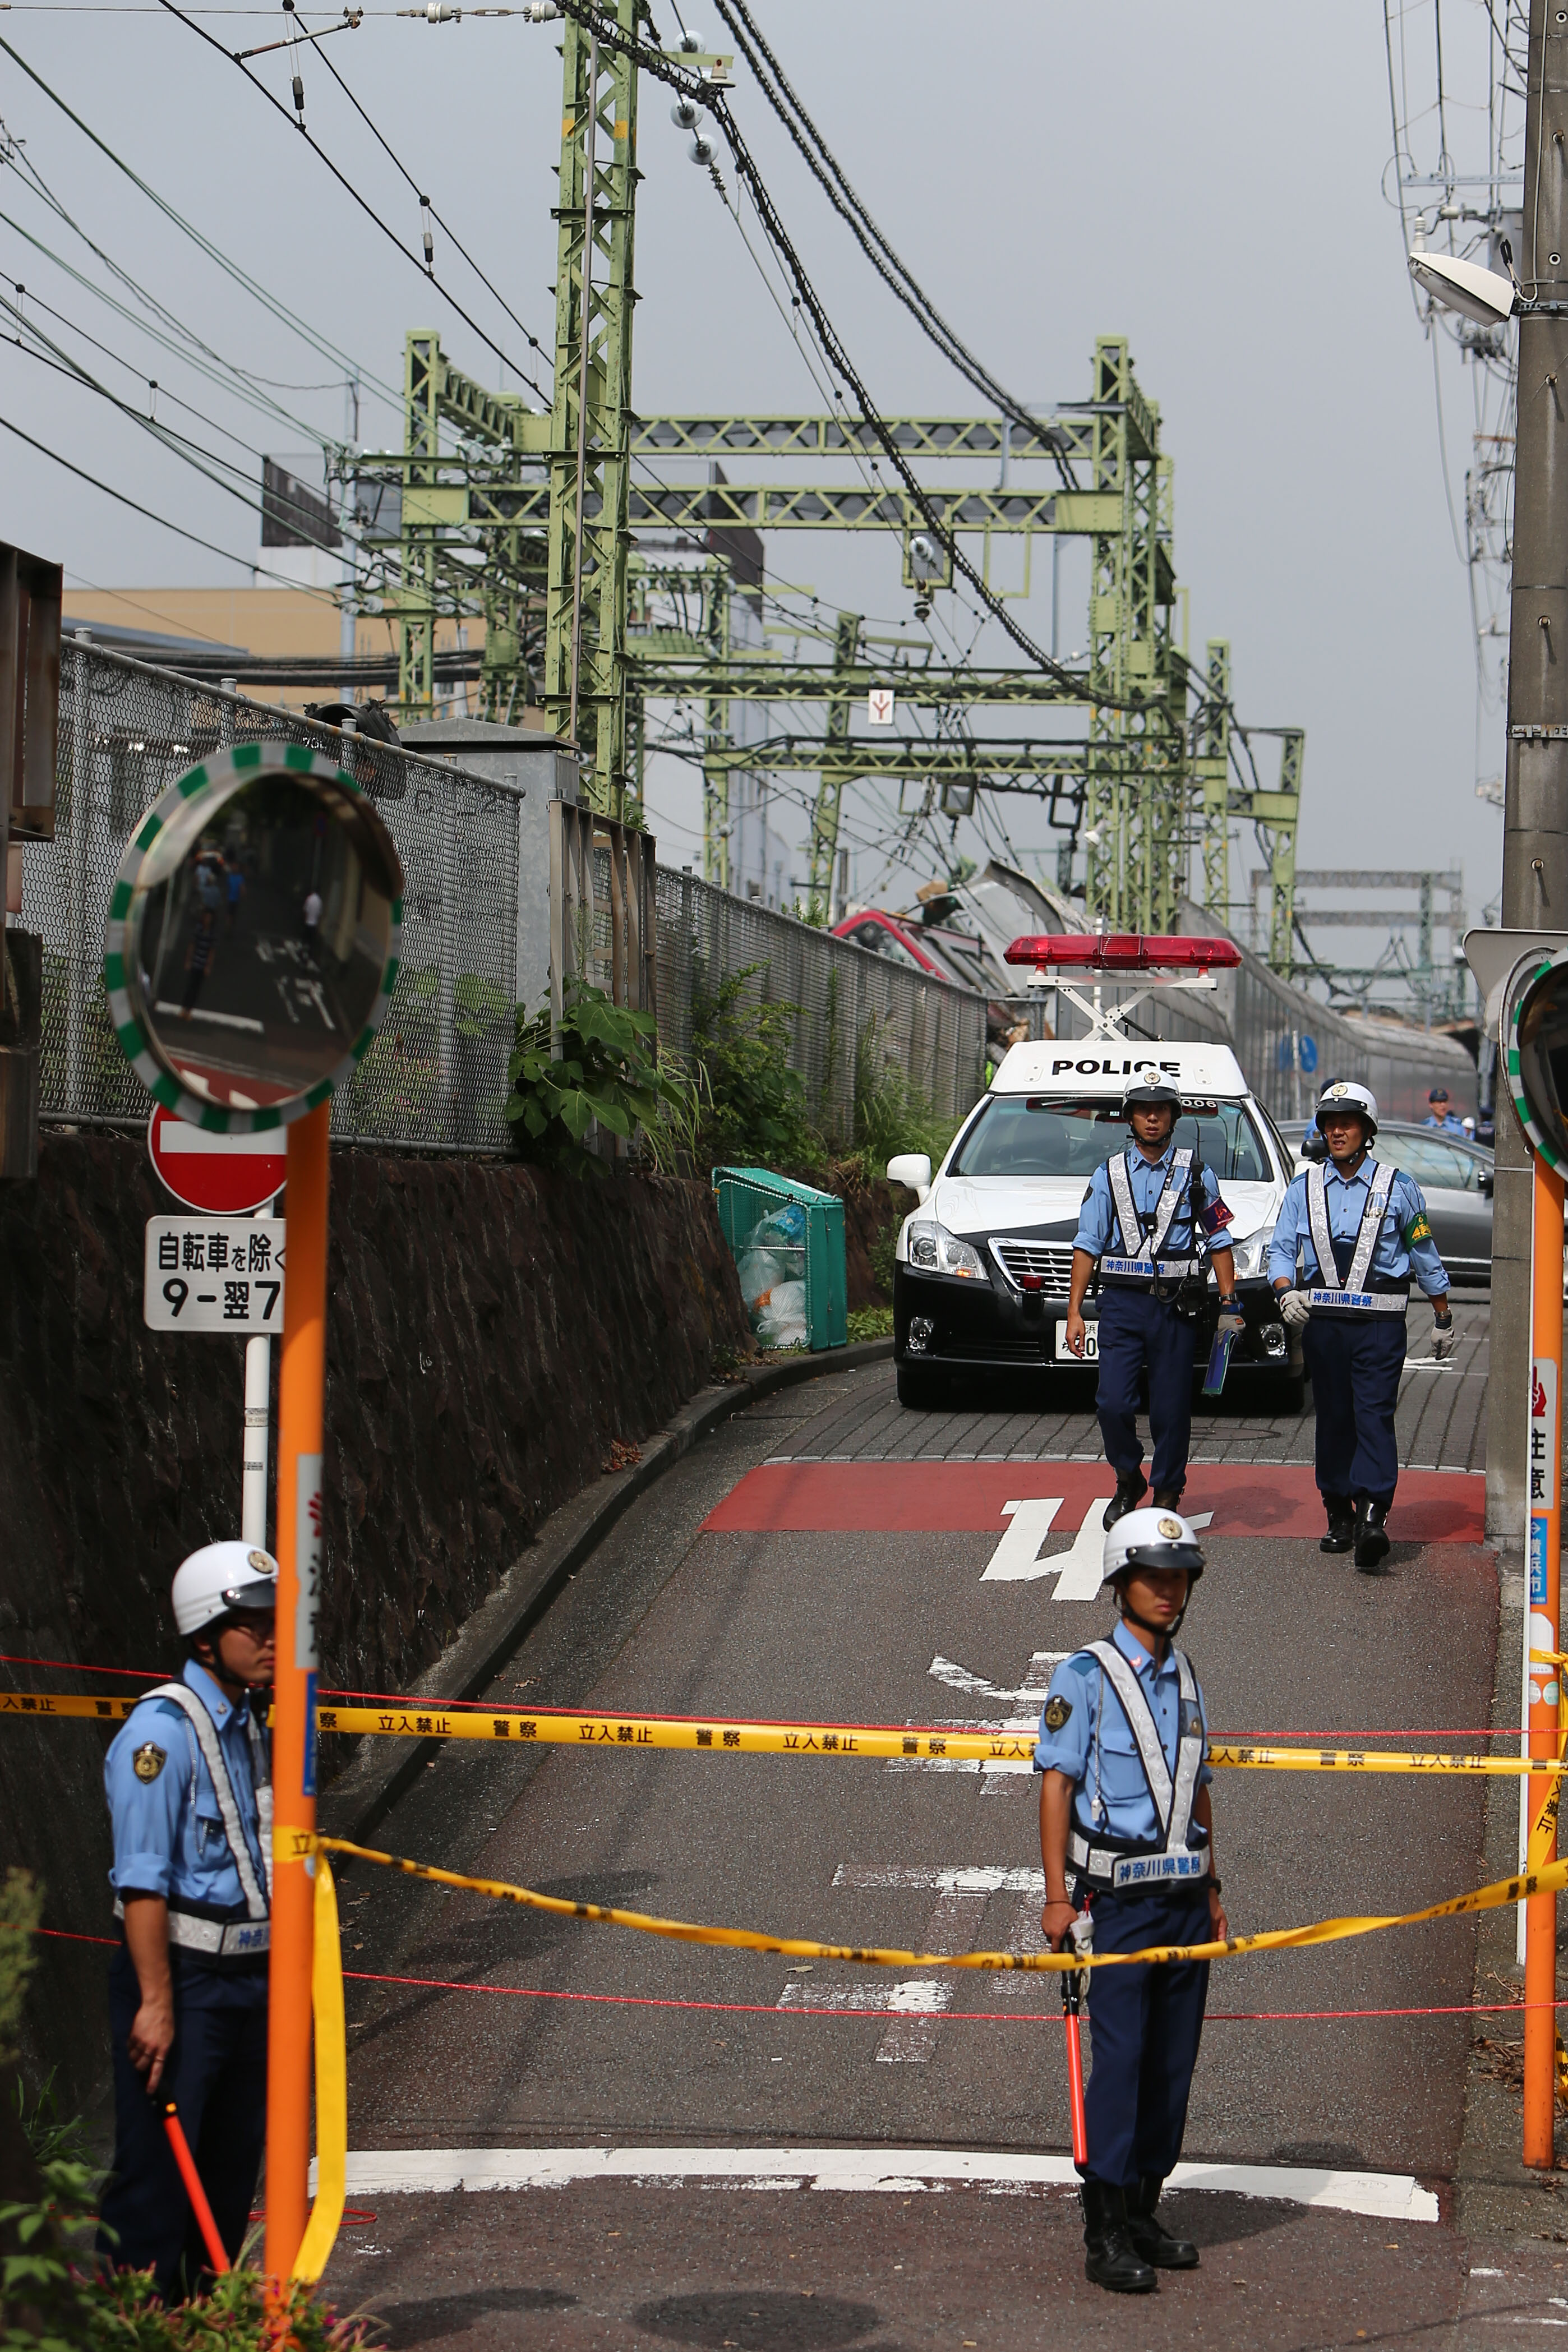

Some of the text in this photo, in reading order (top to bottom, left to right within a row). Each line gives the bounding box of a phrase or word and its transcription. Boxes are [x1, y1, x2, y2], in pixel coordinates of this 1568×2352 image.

[1052, 1060, 1180, 1077] POLICE
[159, 1232, 287, 1273] 自転車を除く
[1106, 1260, 1165, 1275] 神奈川県警察
[1313, 1292, 1372, 1307] 神奈川県警察
[0, 1696, 56, 1712] 入禁止
[378, 1715, 452, 1734] 立入禁止
[579, 1723, 653, 1743] 立入禁止
[783, 1731, 859, 1751] 立入禁止
[1409, 1754, 1487, 1769] 立入禁止
[1119, 1856, 1201, 1881] 神奈川県警察
